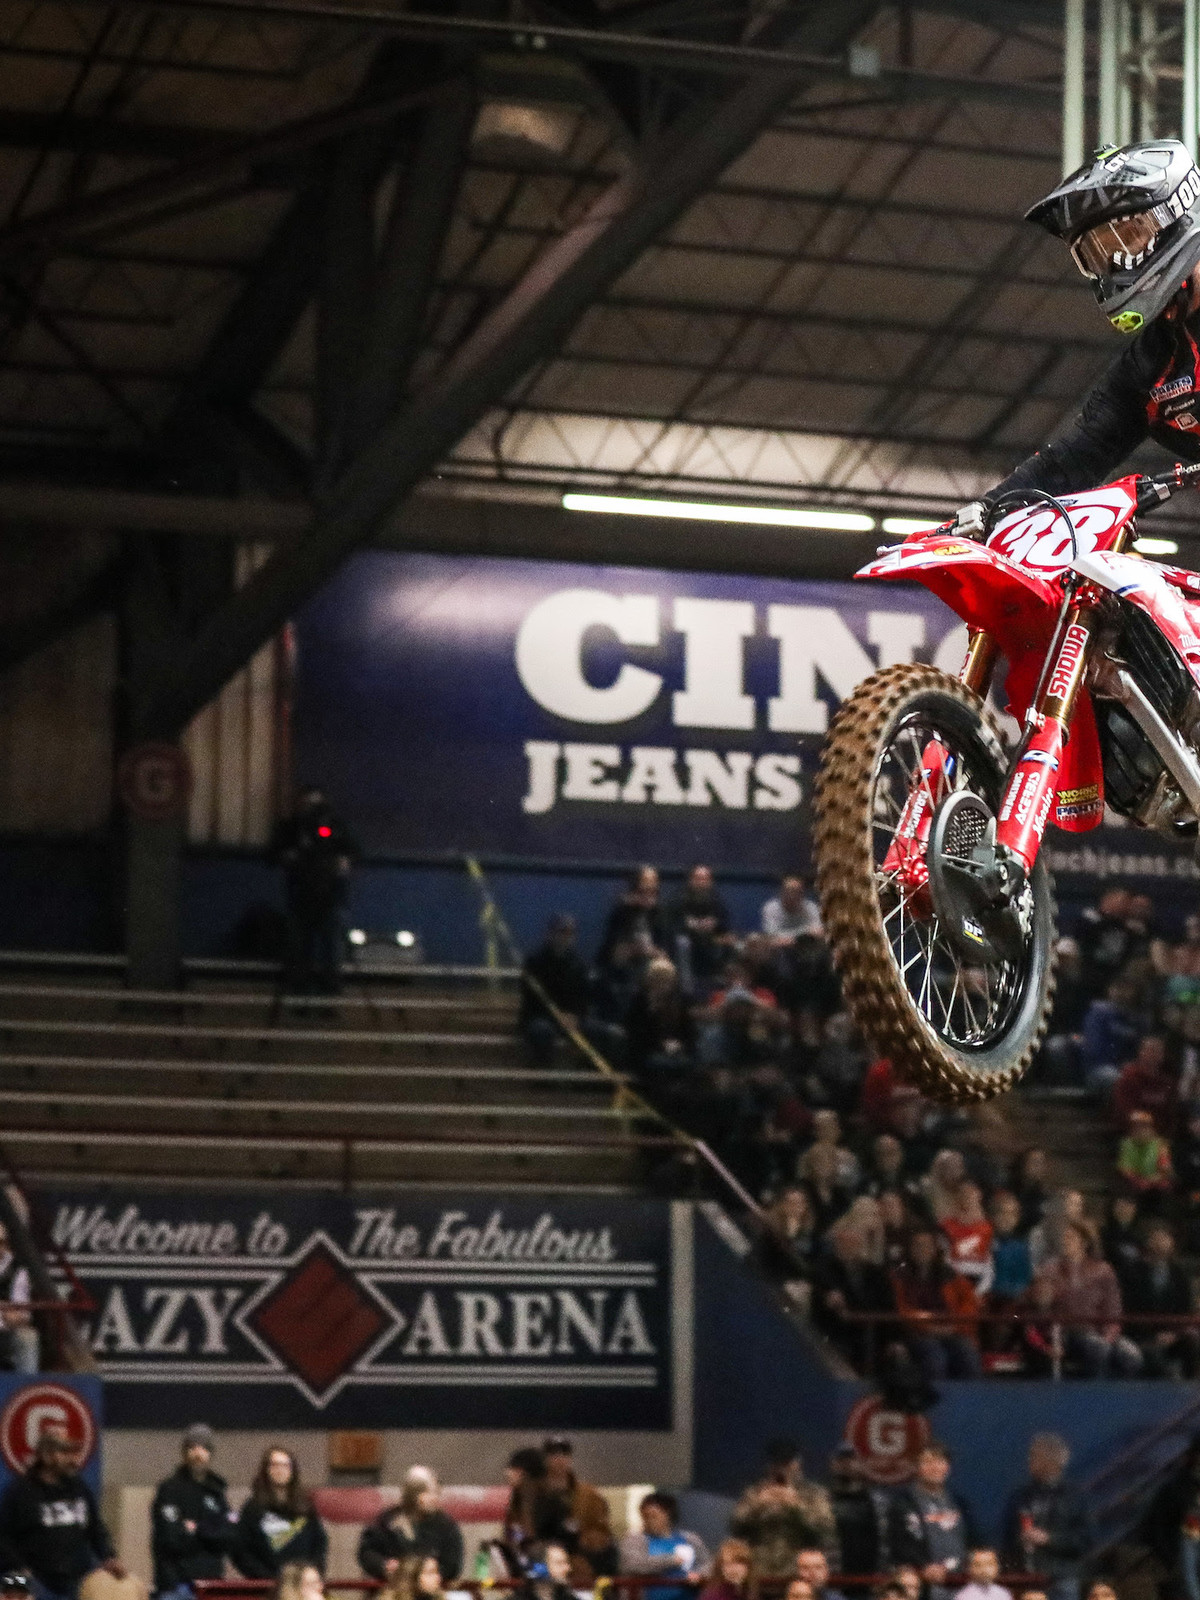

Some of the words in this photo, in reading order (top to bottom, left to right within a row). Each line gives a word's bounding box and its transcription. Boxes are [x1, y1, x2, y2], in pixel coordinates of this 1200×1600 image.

[1001, 507, 1116, 567] 38
[514, 590, 985, 733] CIN
[1050, 626, 1087, 699] SHOWA
[522, 741, 801, 814] JEANS
[1015, 771, 1041, 826] ACERBIS
[964, 921, 983, 937] DP
[52, 1204, 237, 1252] Welcome
[249, 1211, 288, 1251] to
[352, 1209, 420, 1254] The
[429, 1210, 617, 1261] Fabulous
[402, 1291, 655, 1355] ARENA
[868, 1412, 906, 1456] G
